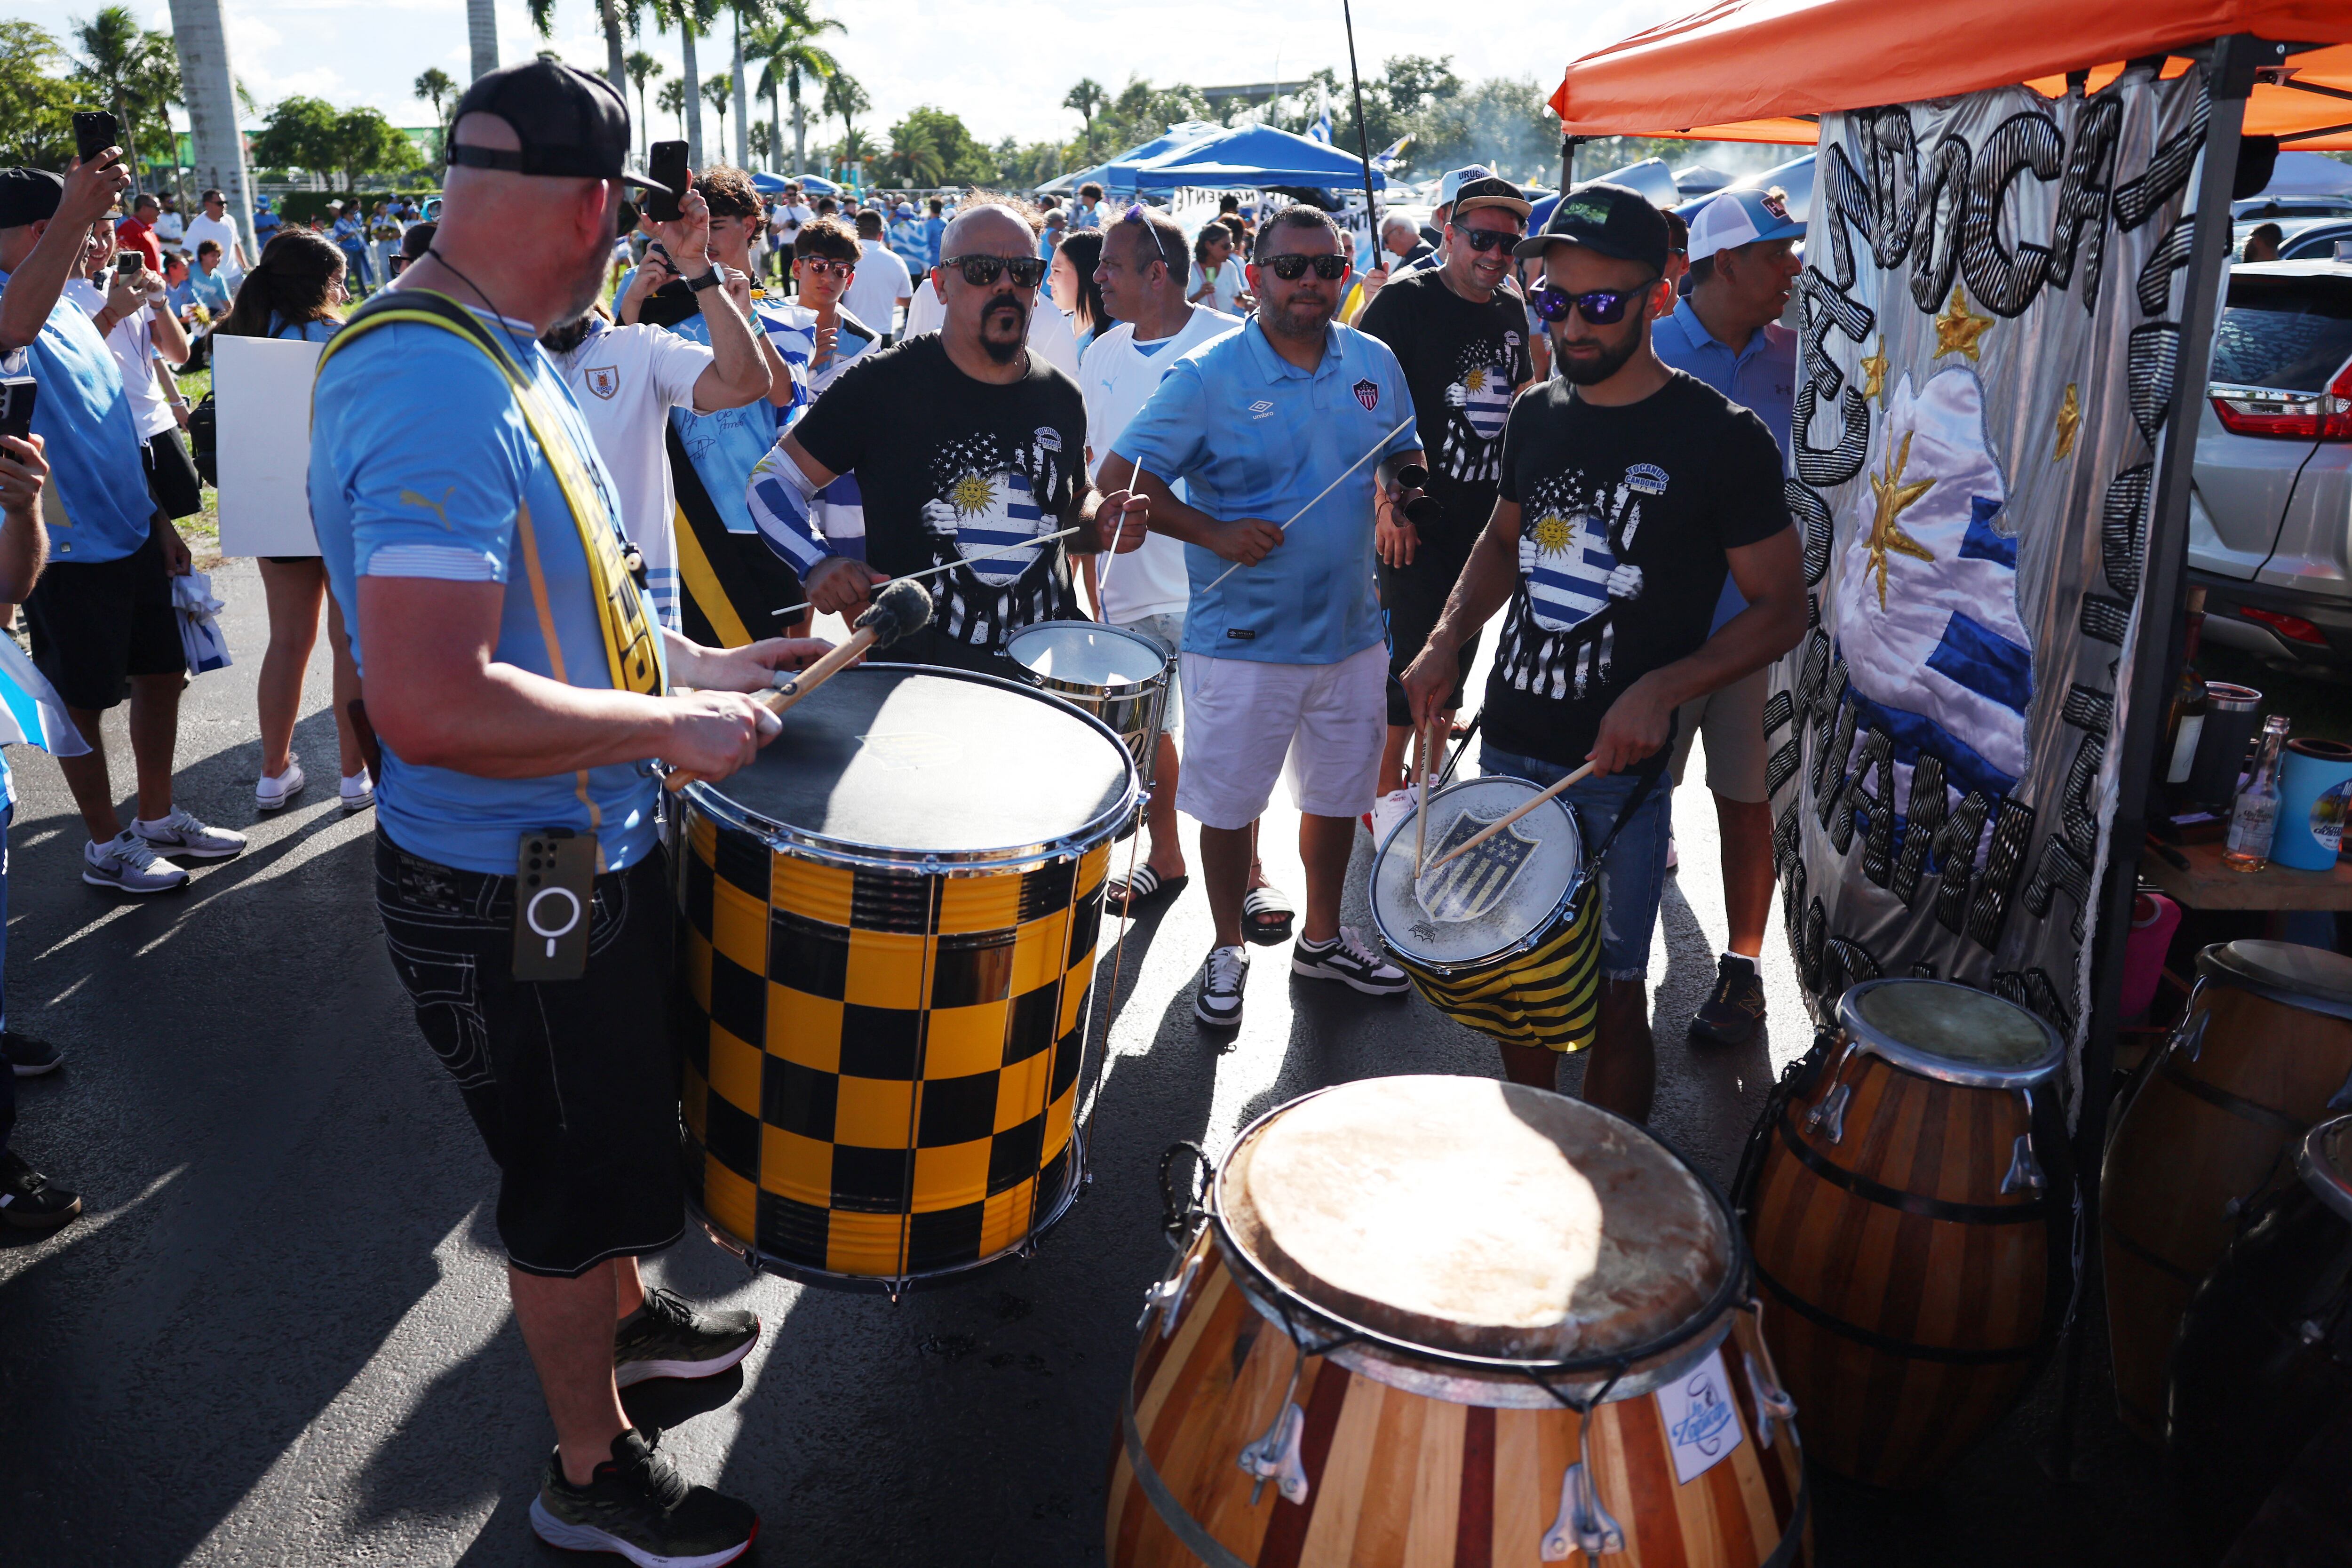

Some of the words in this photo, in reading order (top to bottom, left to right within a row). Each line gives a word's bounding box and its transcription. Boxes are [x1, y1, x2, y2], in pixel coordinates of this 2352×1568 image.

[1034, 426, 1061, 442] TOCANDO
[1036, 436, 1061, 449] CANDOMBE
[1626, 463, 1669, 483] TOCANDO
[1625, 475, 1667, 491] CANDOMBE
[1414, 927, 1433, 938] REMO
